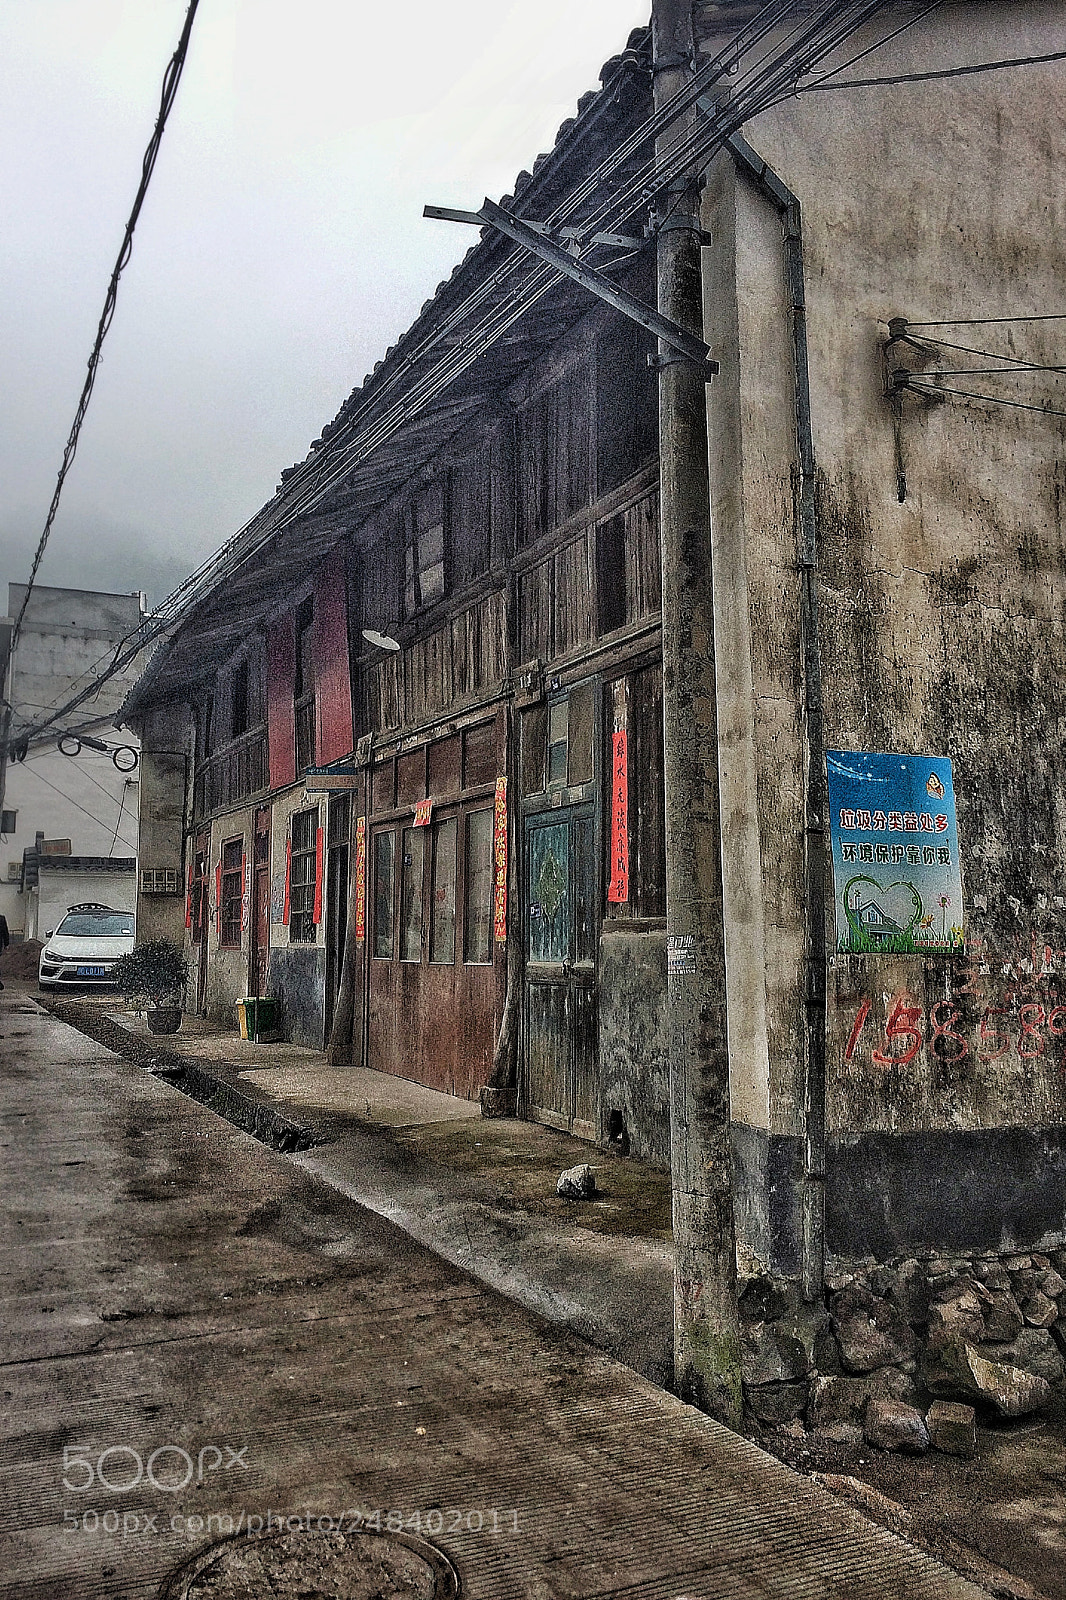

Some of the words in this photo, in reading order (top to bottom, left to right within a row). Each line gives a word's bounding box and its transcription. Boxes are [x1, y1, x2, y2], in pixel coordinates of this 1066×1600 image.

[840, 809, 949, 833] 垃圾分类益处多
[842, 842, 952, 866] 环境保护靠你我
